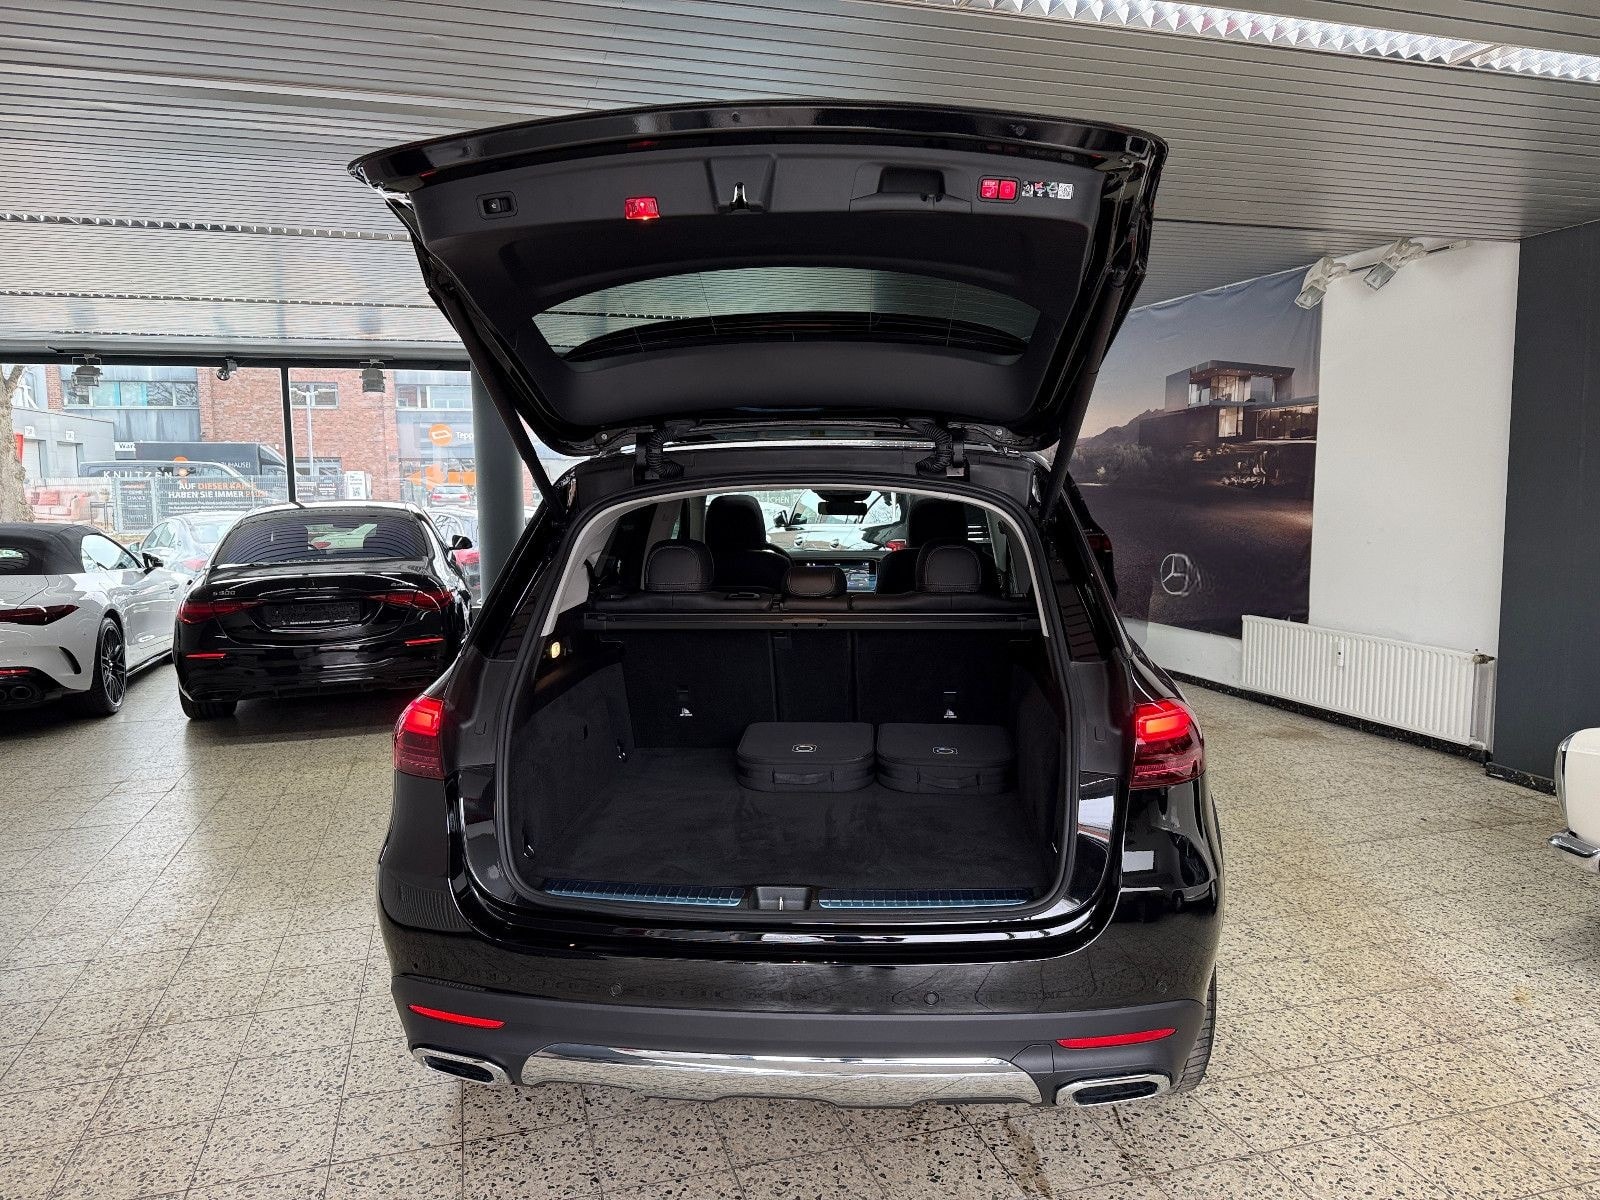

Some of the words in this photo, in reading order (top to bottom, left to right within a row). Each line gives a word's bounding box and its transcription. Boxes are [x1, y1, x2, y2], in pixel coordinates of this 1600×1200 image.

[103, 470, 173, 480] KNUTZEN
[179, 483, 196, 491] AUF
[197, 482, 229, 491] DIESER
[168, 491, 198, 499] HABEN
[214, 490, 244, 498] IMMER
